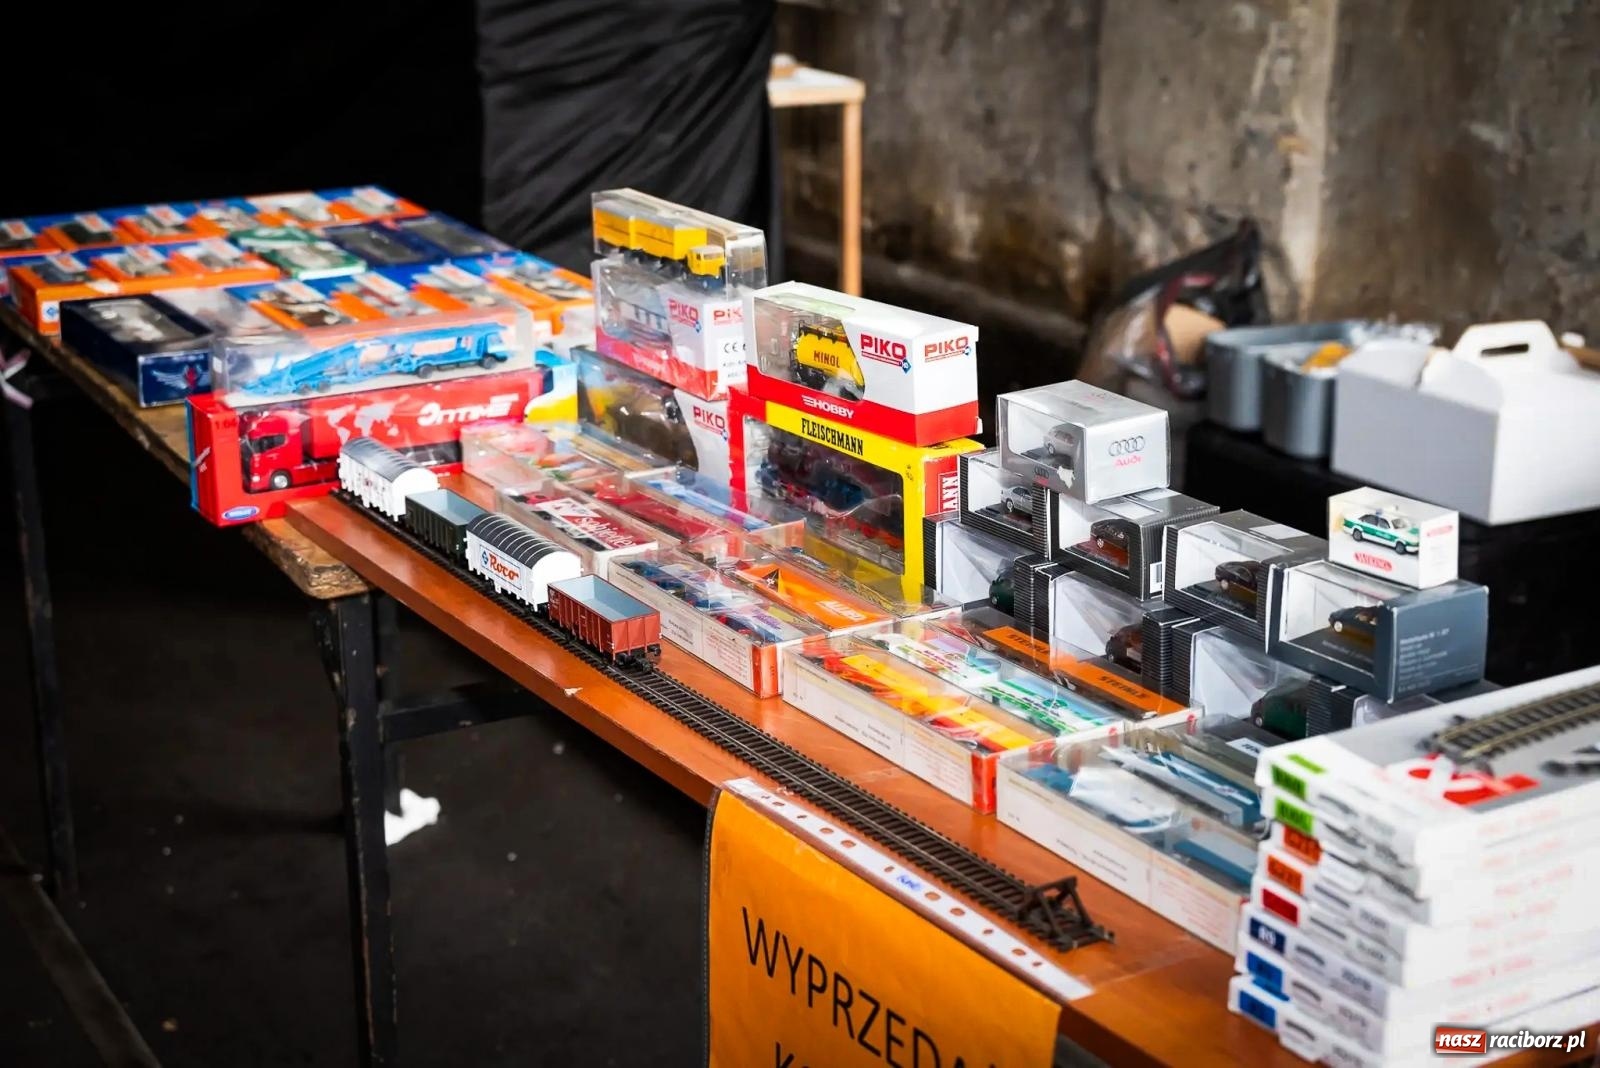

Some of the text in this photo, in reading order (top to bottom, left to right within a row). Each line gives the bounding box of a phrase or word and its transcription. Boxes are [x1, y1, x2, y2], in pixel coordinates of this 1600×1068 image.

[668, 298, 699, 321] PIKO
[814, 350, 841, 368] MINOL
[860, 333, 907, 360] PIKO
[924, 336, 969, 358] PIKO
[693, 405, 725, 431] PIKO
[812, 400, 854, 419] HOBBY
[801, 417, 864, 456] FLEISCHMANN
[489, 552, 520, 581] Roco
[742, 906, 997, 1068] WYPRZED
